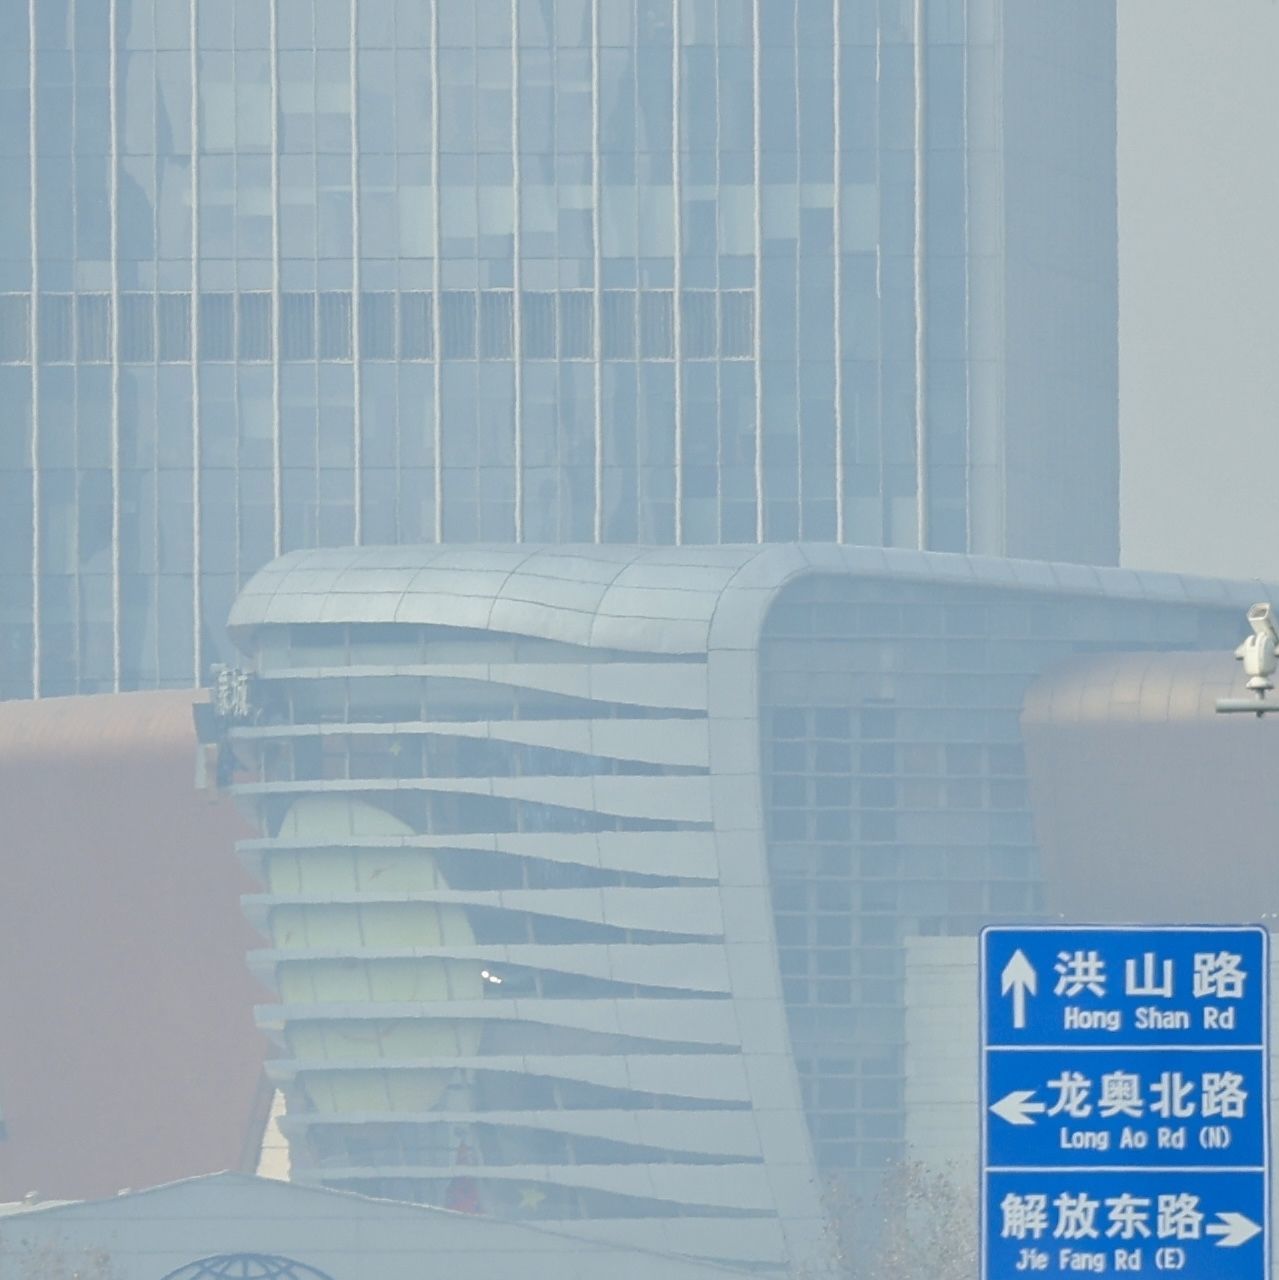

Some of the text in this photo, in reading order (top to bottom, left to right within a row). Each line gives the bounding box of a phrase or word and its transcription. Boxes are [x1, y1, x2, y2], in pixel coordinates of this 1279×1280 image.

[1053, 951, 1247, 999] 洪山路
[1064, 1007, 1235, 1031] Hong Shan Rd
[1046, 1071, 1248, 1119] 龙奥北路
[1060, 1126, 1231, 1151] Long Ao Rd (N)
[1001, 1192, 1204, 1240] 解放东路
[1016, 1248, 1185, 1272] Jie Fang Rd (E)
